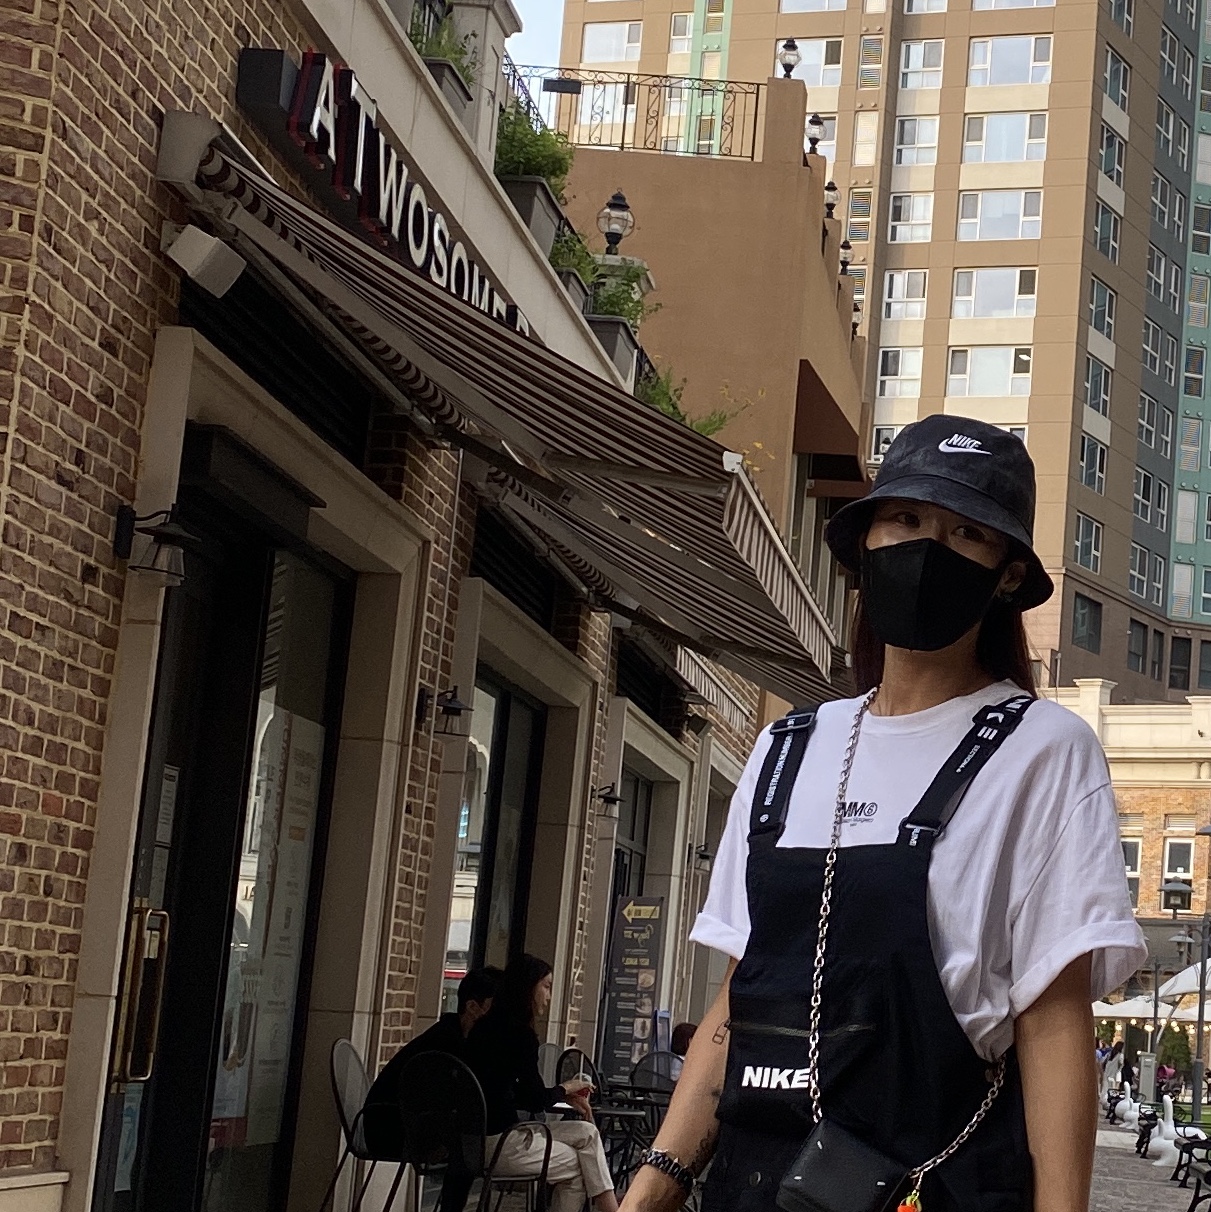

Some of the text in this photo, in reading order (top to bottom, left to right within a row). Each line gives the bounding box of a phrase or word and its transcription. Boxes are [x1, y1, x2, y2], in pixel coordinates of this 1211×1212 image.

[309, 57, 337, 165] A
[947, 433, 982, 449] NIKE
[741, 1066, 811, 1090] NIKE
